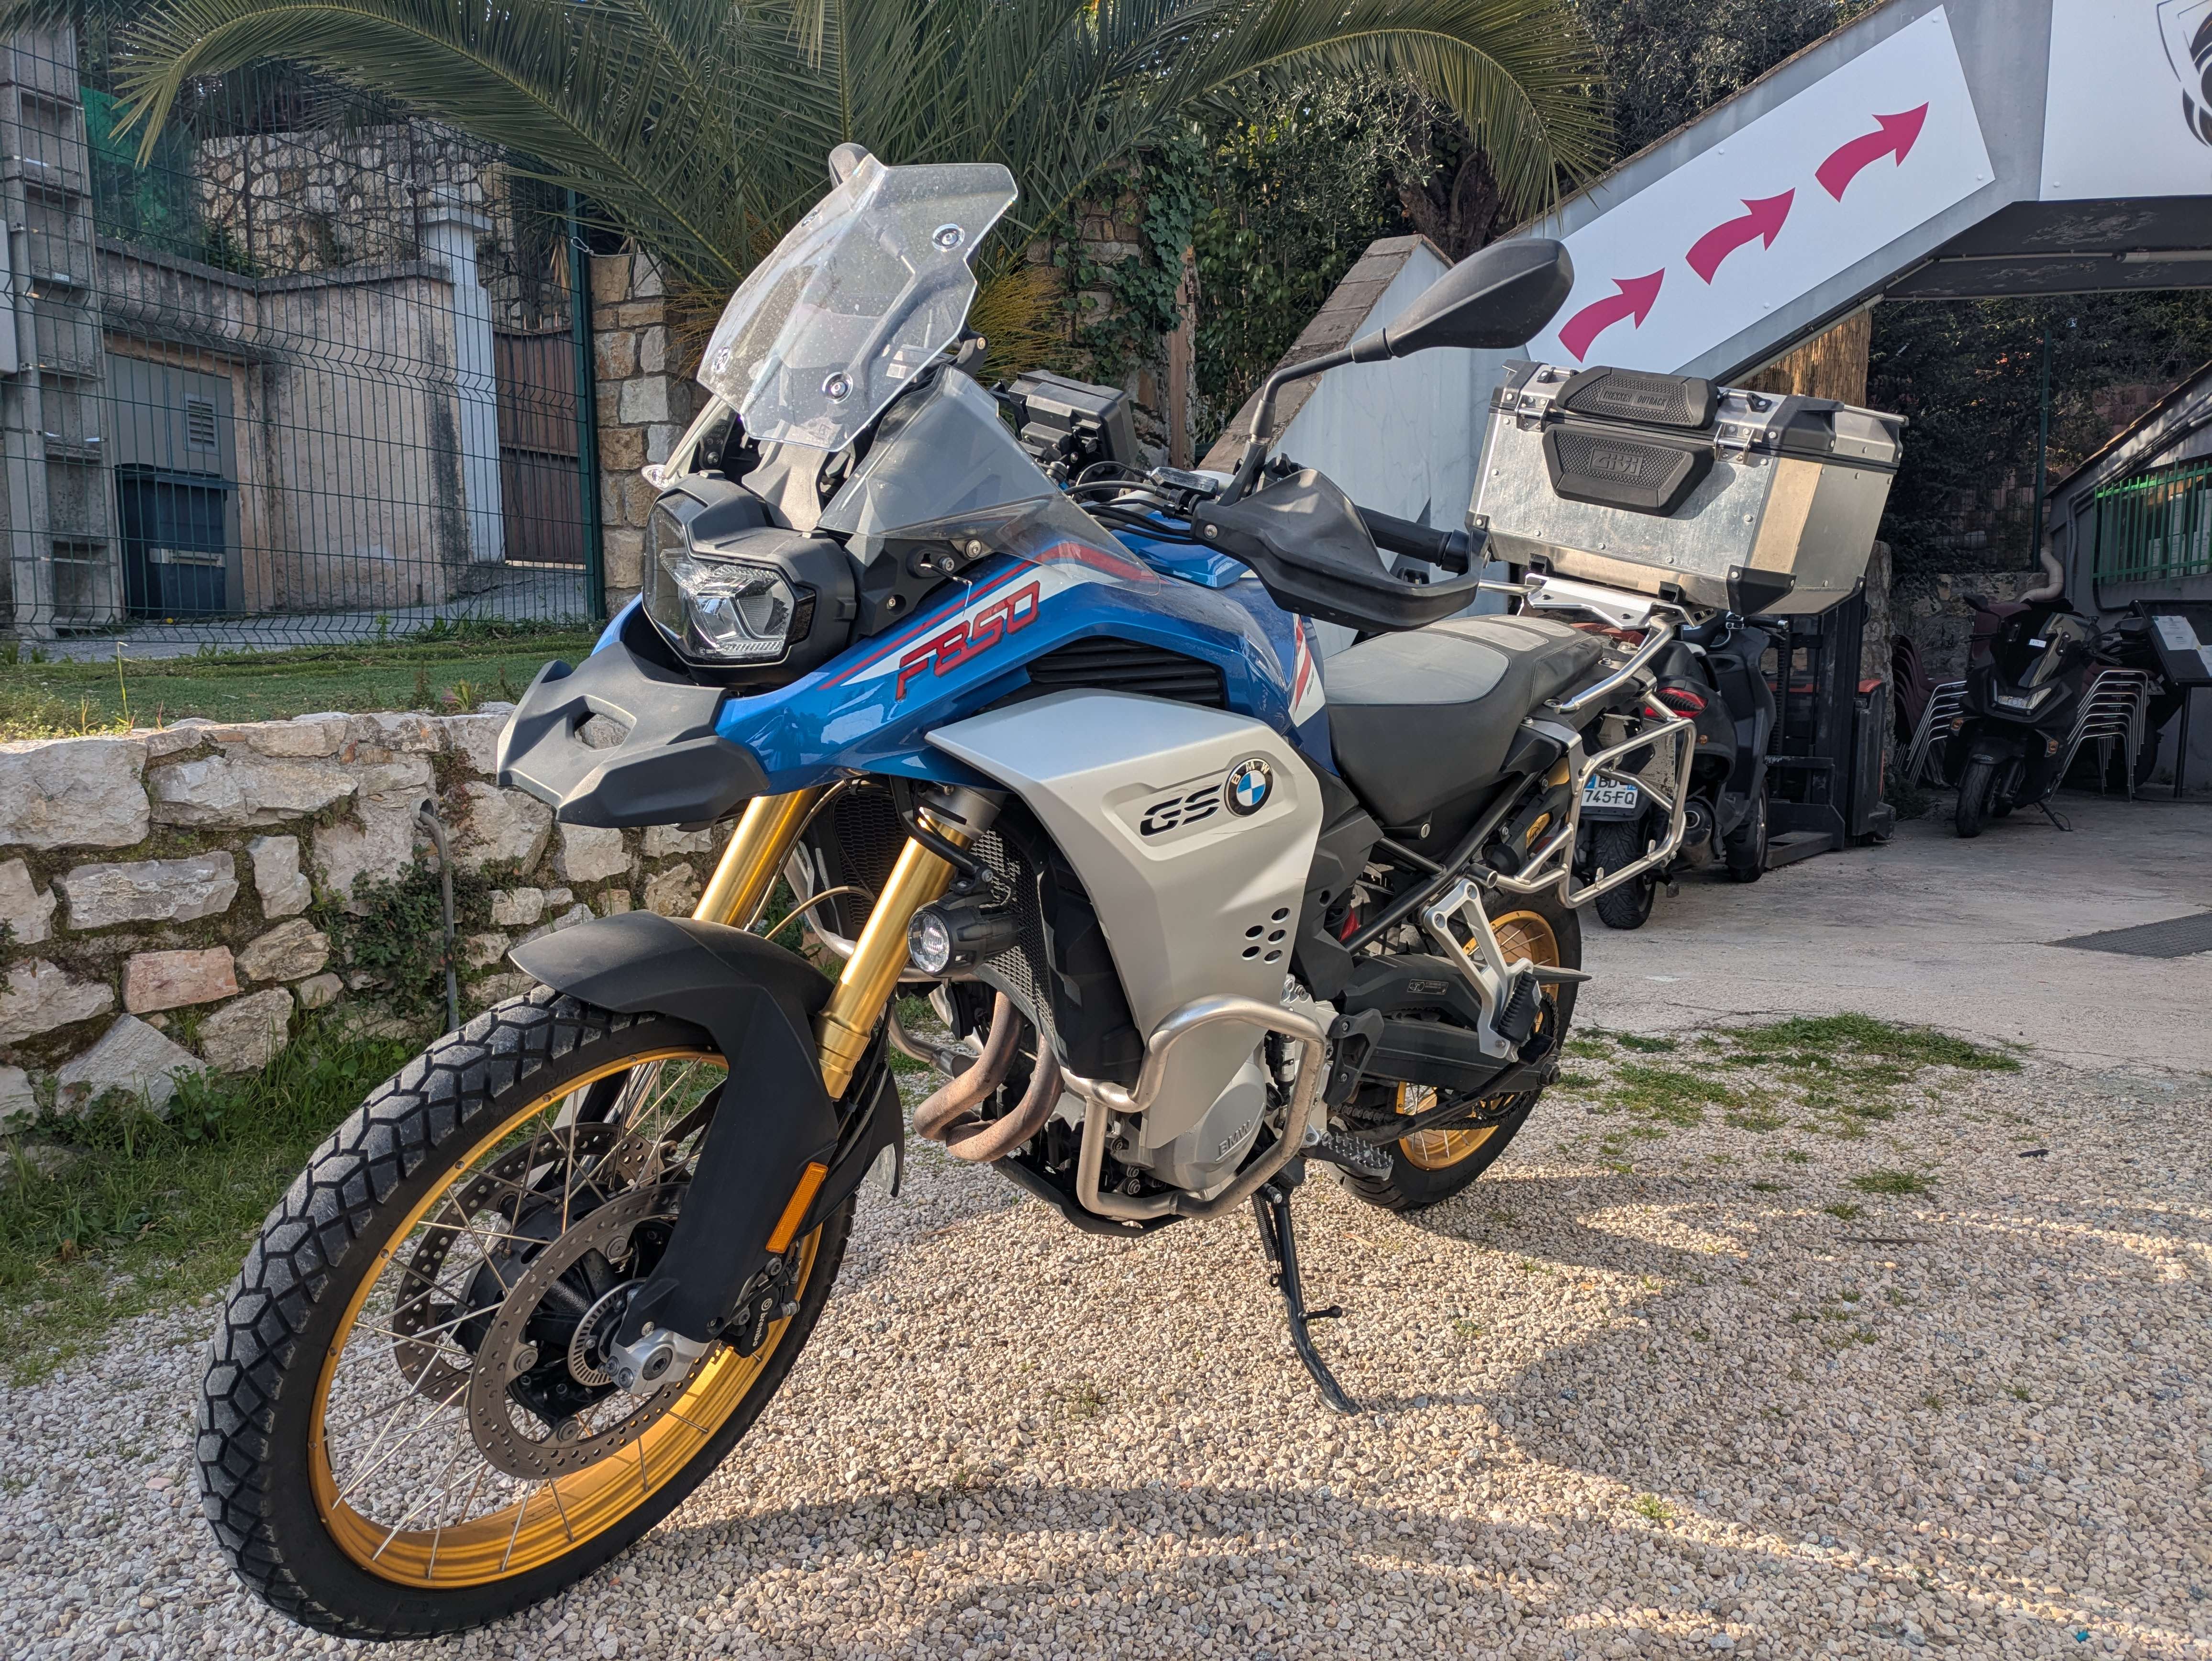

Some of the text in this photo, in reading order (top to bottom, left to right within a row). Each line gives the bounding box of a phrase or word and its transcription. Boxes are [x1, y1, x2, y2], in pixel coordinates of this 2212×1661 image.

[1637, 395, 1667, 407] OUTBACK
[895, 580, 1040, 701] F850
[1231, 761, 1270, 785] BMW
[1139, 782, 1223, 836] GS
[1585, 790, 1635, 805] 745-FQ
[1218, 1119, 1250, 1156] BMW
[752, 1312, 768, 1347] brembo
